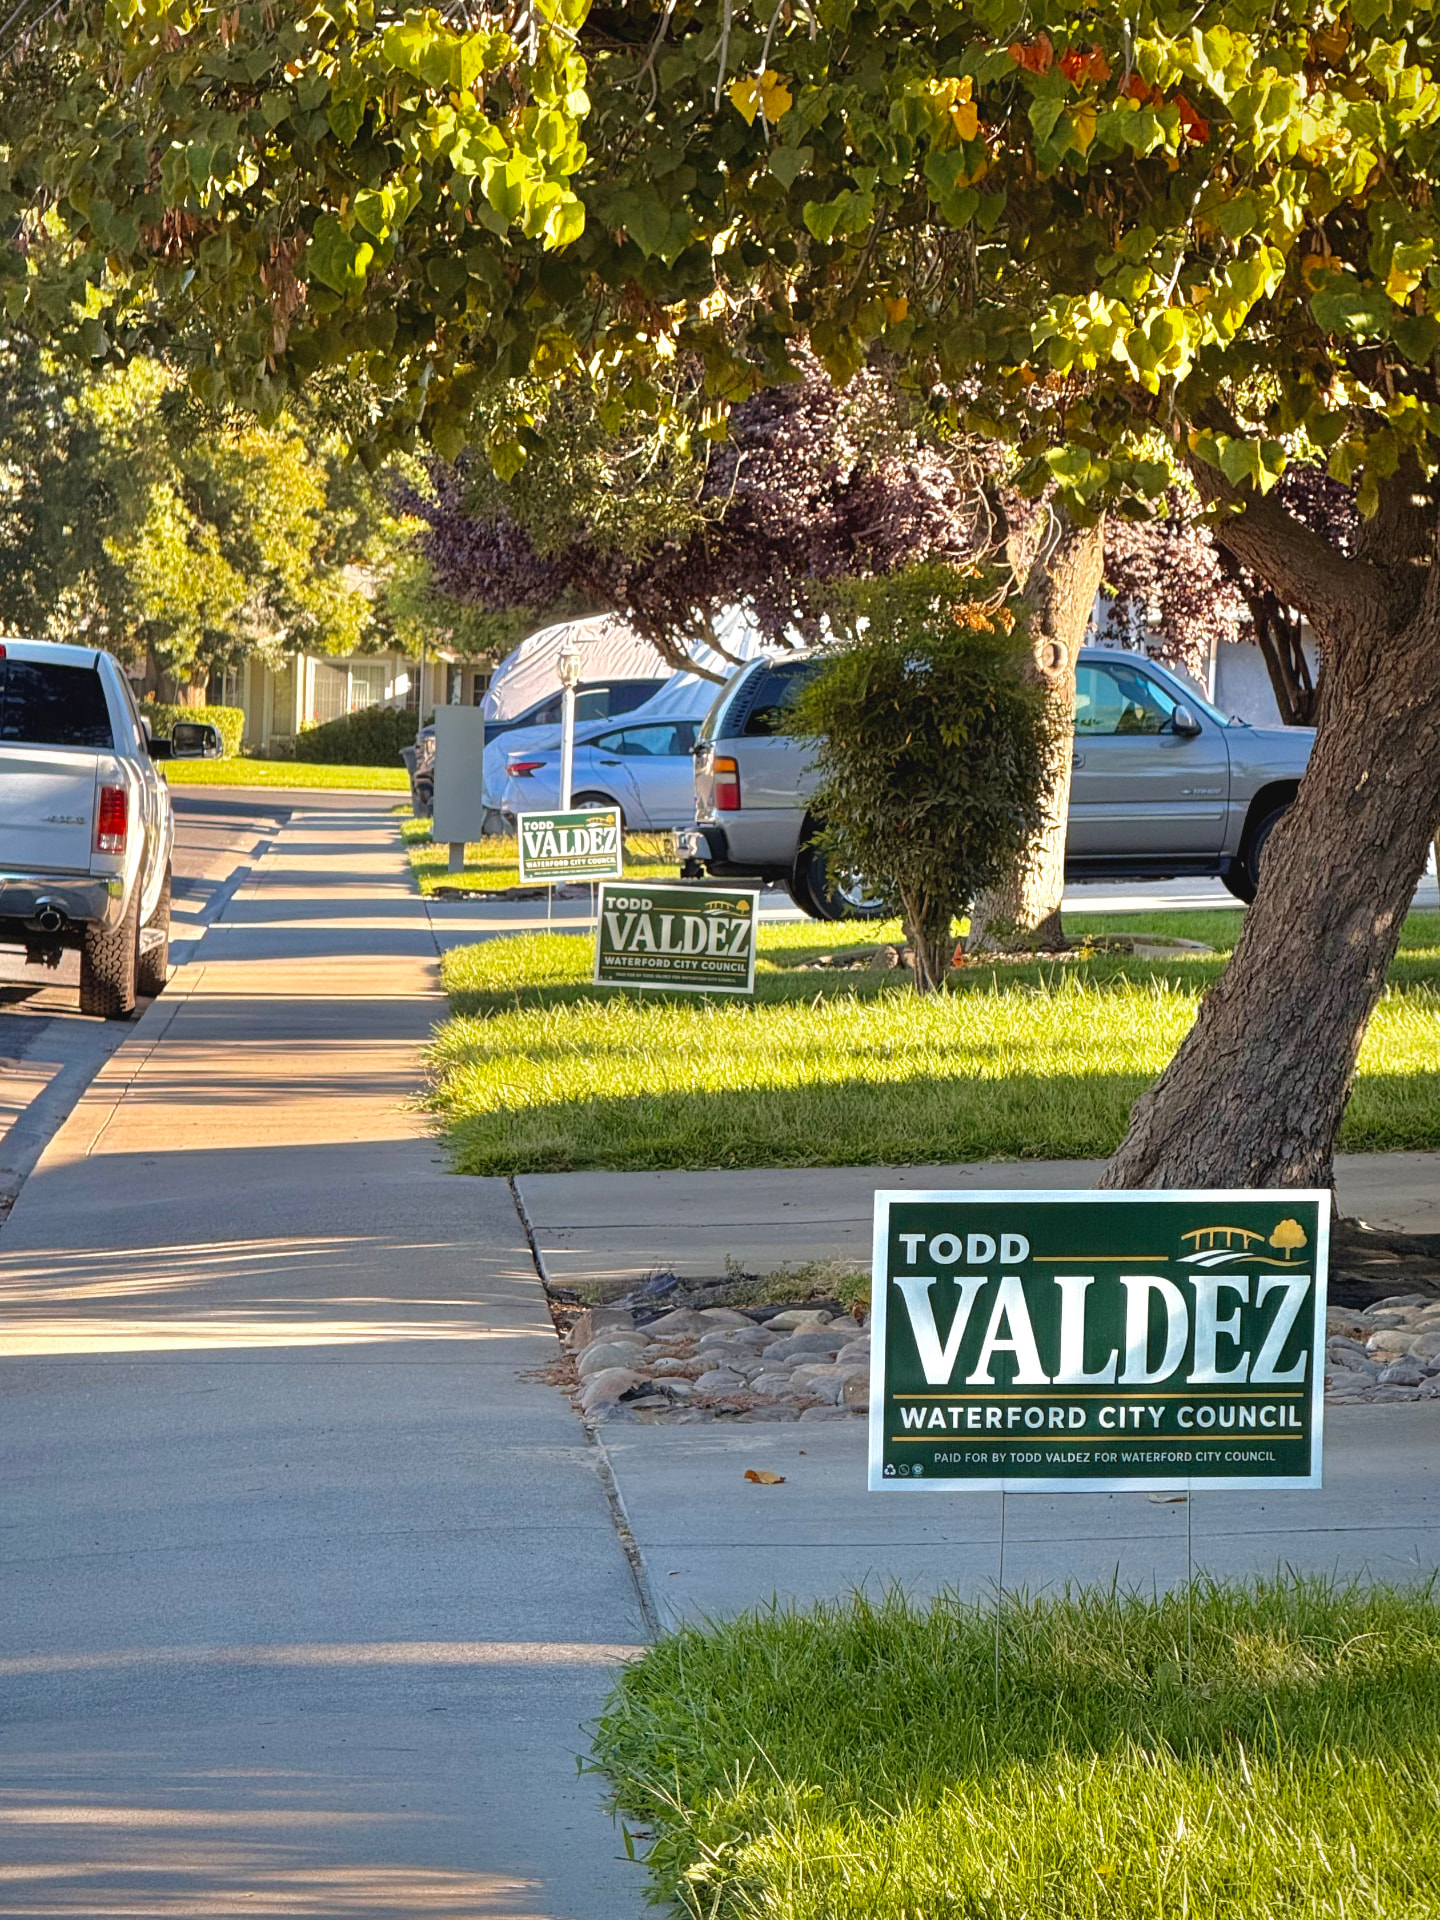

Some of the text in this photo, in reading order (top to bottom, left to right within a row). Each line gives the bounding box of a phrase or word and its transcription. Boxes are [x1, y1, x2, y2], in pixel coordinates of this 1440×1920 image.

[523, 821, 555, 831] TODD
[522, 827, 617, 858] VALDEZ
[526, 859, 569, 868] WATERFORD
[569, 858, 586, 866] CITY
[605, 897, 653, 911] TODD
[603, 911, 751, 957] VALDEZ
[604, 956, 746, 972] WATERFORD CITY COUNCIL
[899, 1233, 1030, 1265] TODD
[893, 1275, 1311, 1385] VALDEZ
[900, 1405, 1303, 1429] WATERFORD CITY COUNCIL
[934, 1451, 1276, 1463] PAID FOR BY TODD VALDEZ FOR WATERFORD CITY COUNCIL
